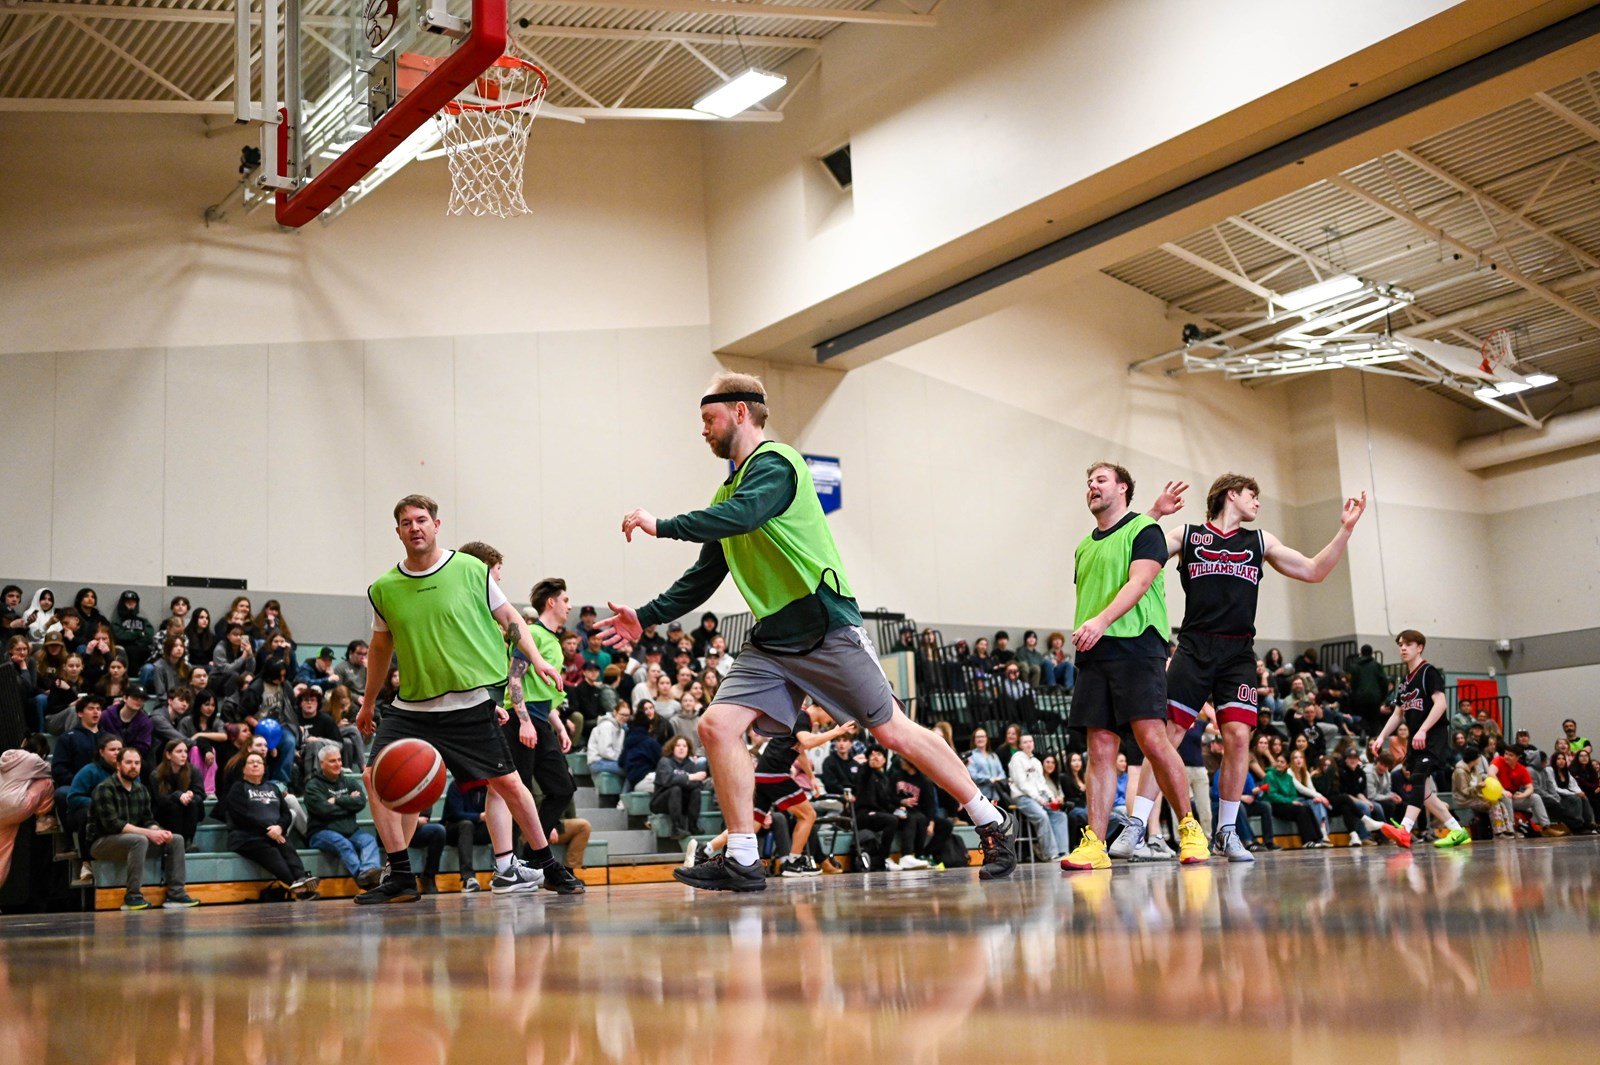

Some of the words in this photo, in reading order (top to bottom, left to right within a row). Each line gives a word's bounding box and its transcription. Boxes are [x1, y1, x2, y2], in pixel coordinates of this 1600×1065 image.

[1190, 532, 1213, 546] 00
[1188, 562, 1234, 579] WILLIAMS
[1234, 564, 1259, 585] LAKE
